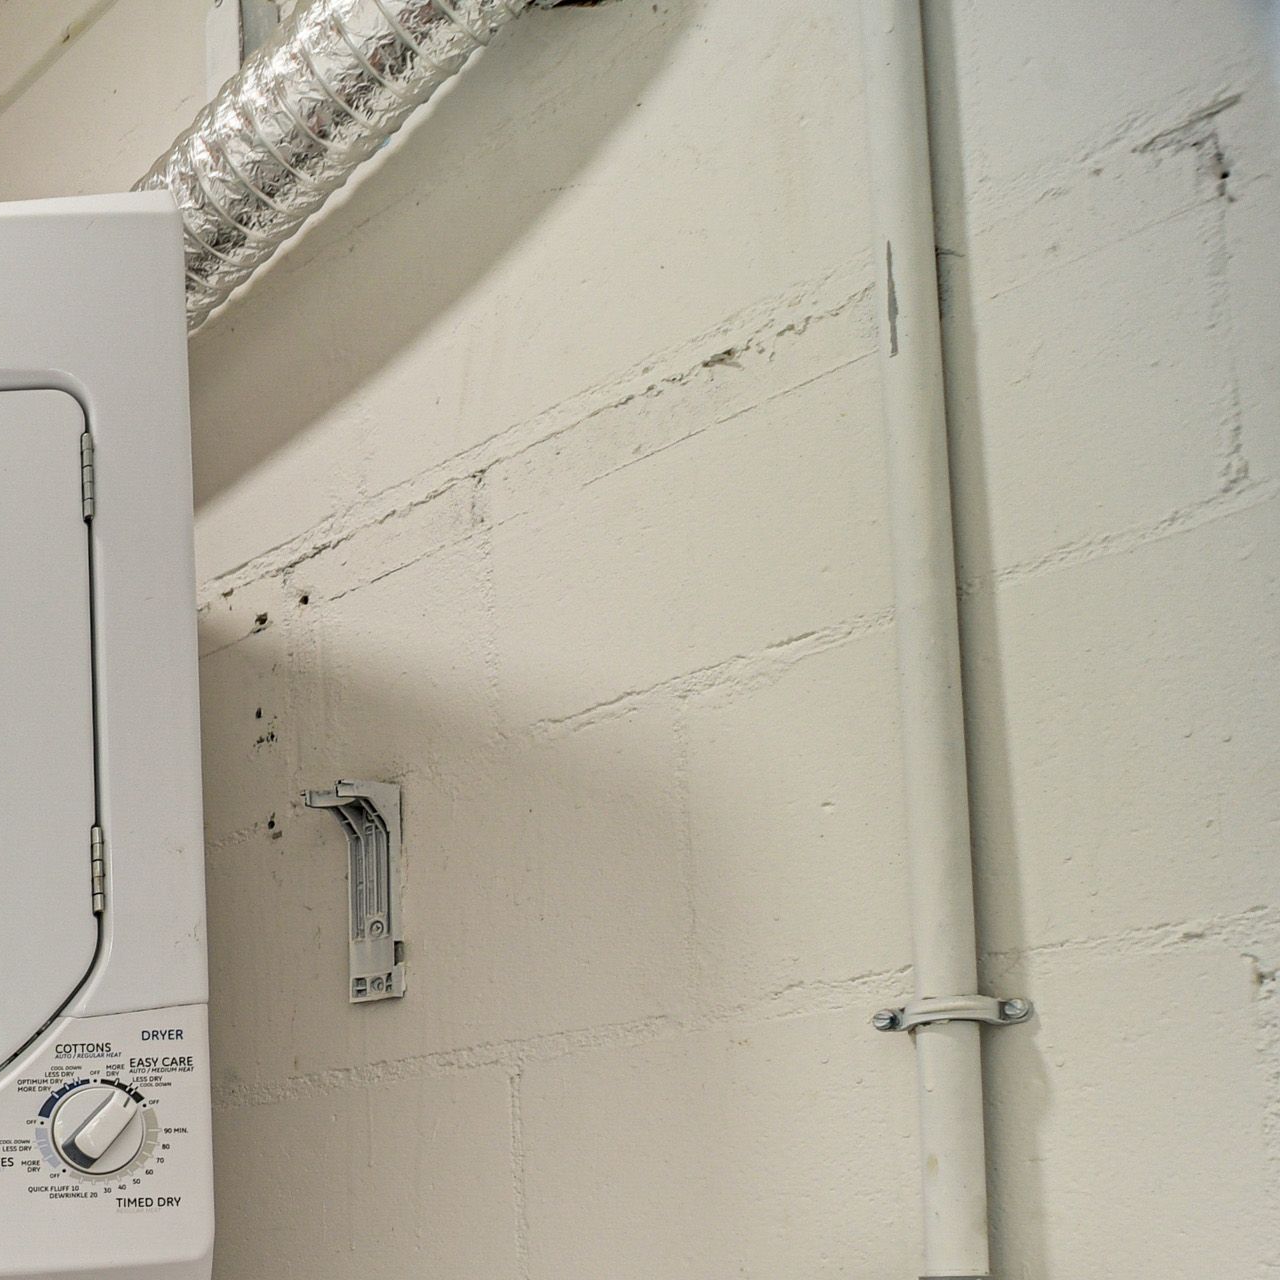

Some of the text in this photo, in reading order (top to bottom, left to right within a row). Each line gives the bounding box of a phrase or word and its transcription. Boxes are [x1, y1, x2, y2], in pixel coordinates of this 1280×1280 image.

[141, 1029, 184, 1041] DRYER
[55, 1043, 112, 1053] COTTONS
[129, 1056, 193, 1068] EASY CARE
[116, 1197, 181, 1208] TIMED DRY
